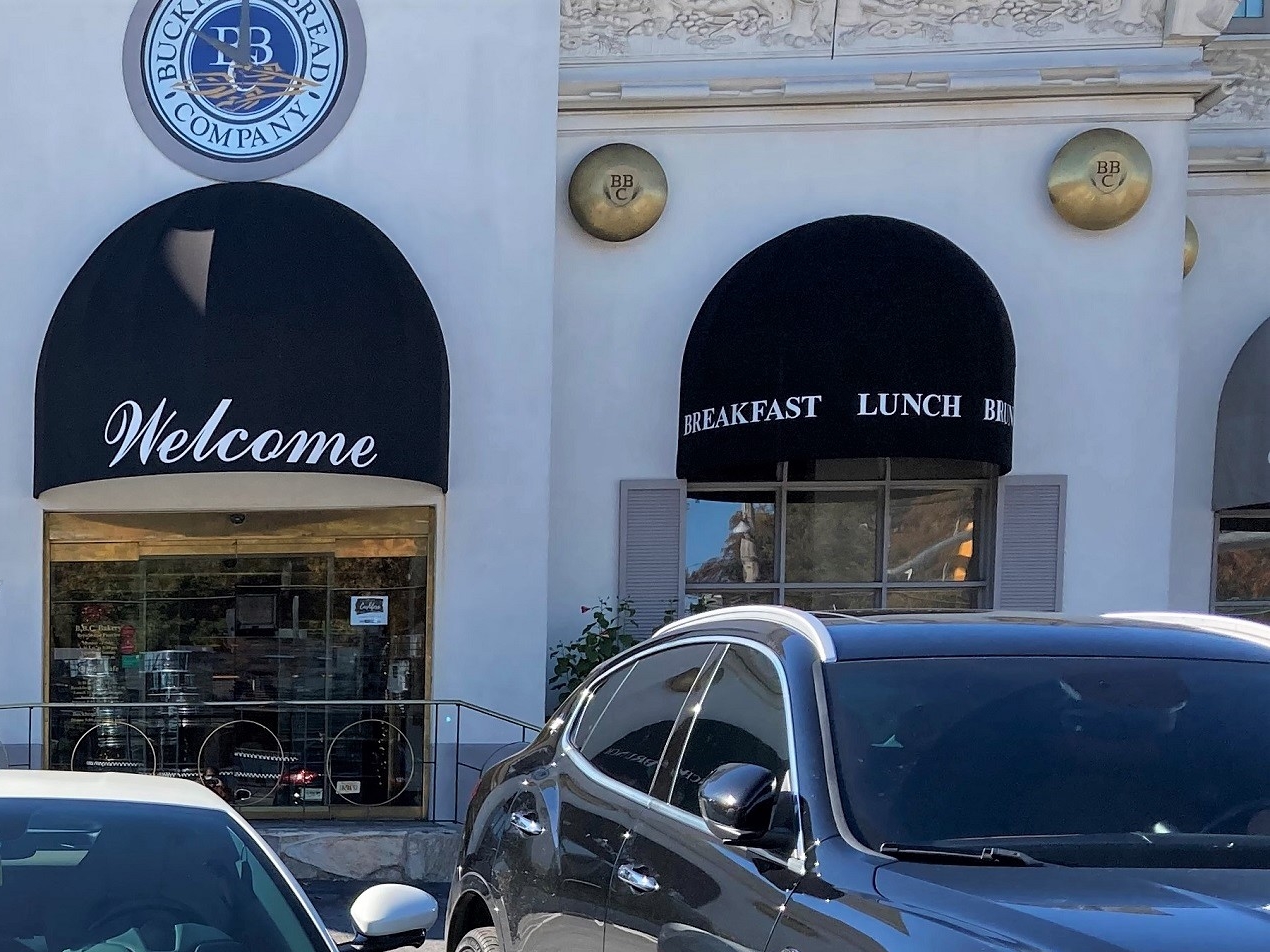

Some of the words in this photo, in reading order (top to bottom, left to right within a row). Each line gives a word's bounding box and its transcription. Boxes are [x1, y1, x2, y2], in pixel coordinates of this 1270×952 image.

[157, 0, 205, 82] BUCK
[174, 100, 311, 149] COMPANY
[610, 174, 634, 188] BB
[1096, 160, 1120, 174] BB
[1101, 174, 1115, 188] C
[615, 187, 628, 201] C
[683, 395, 822, 436] BREAKFAST
[857, 392, 962, 418] LUNCH
[104, 397, 378, 468] Welcome
